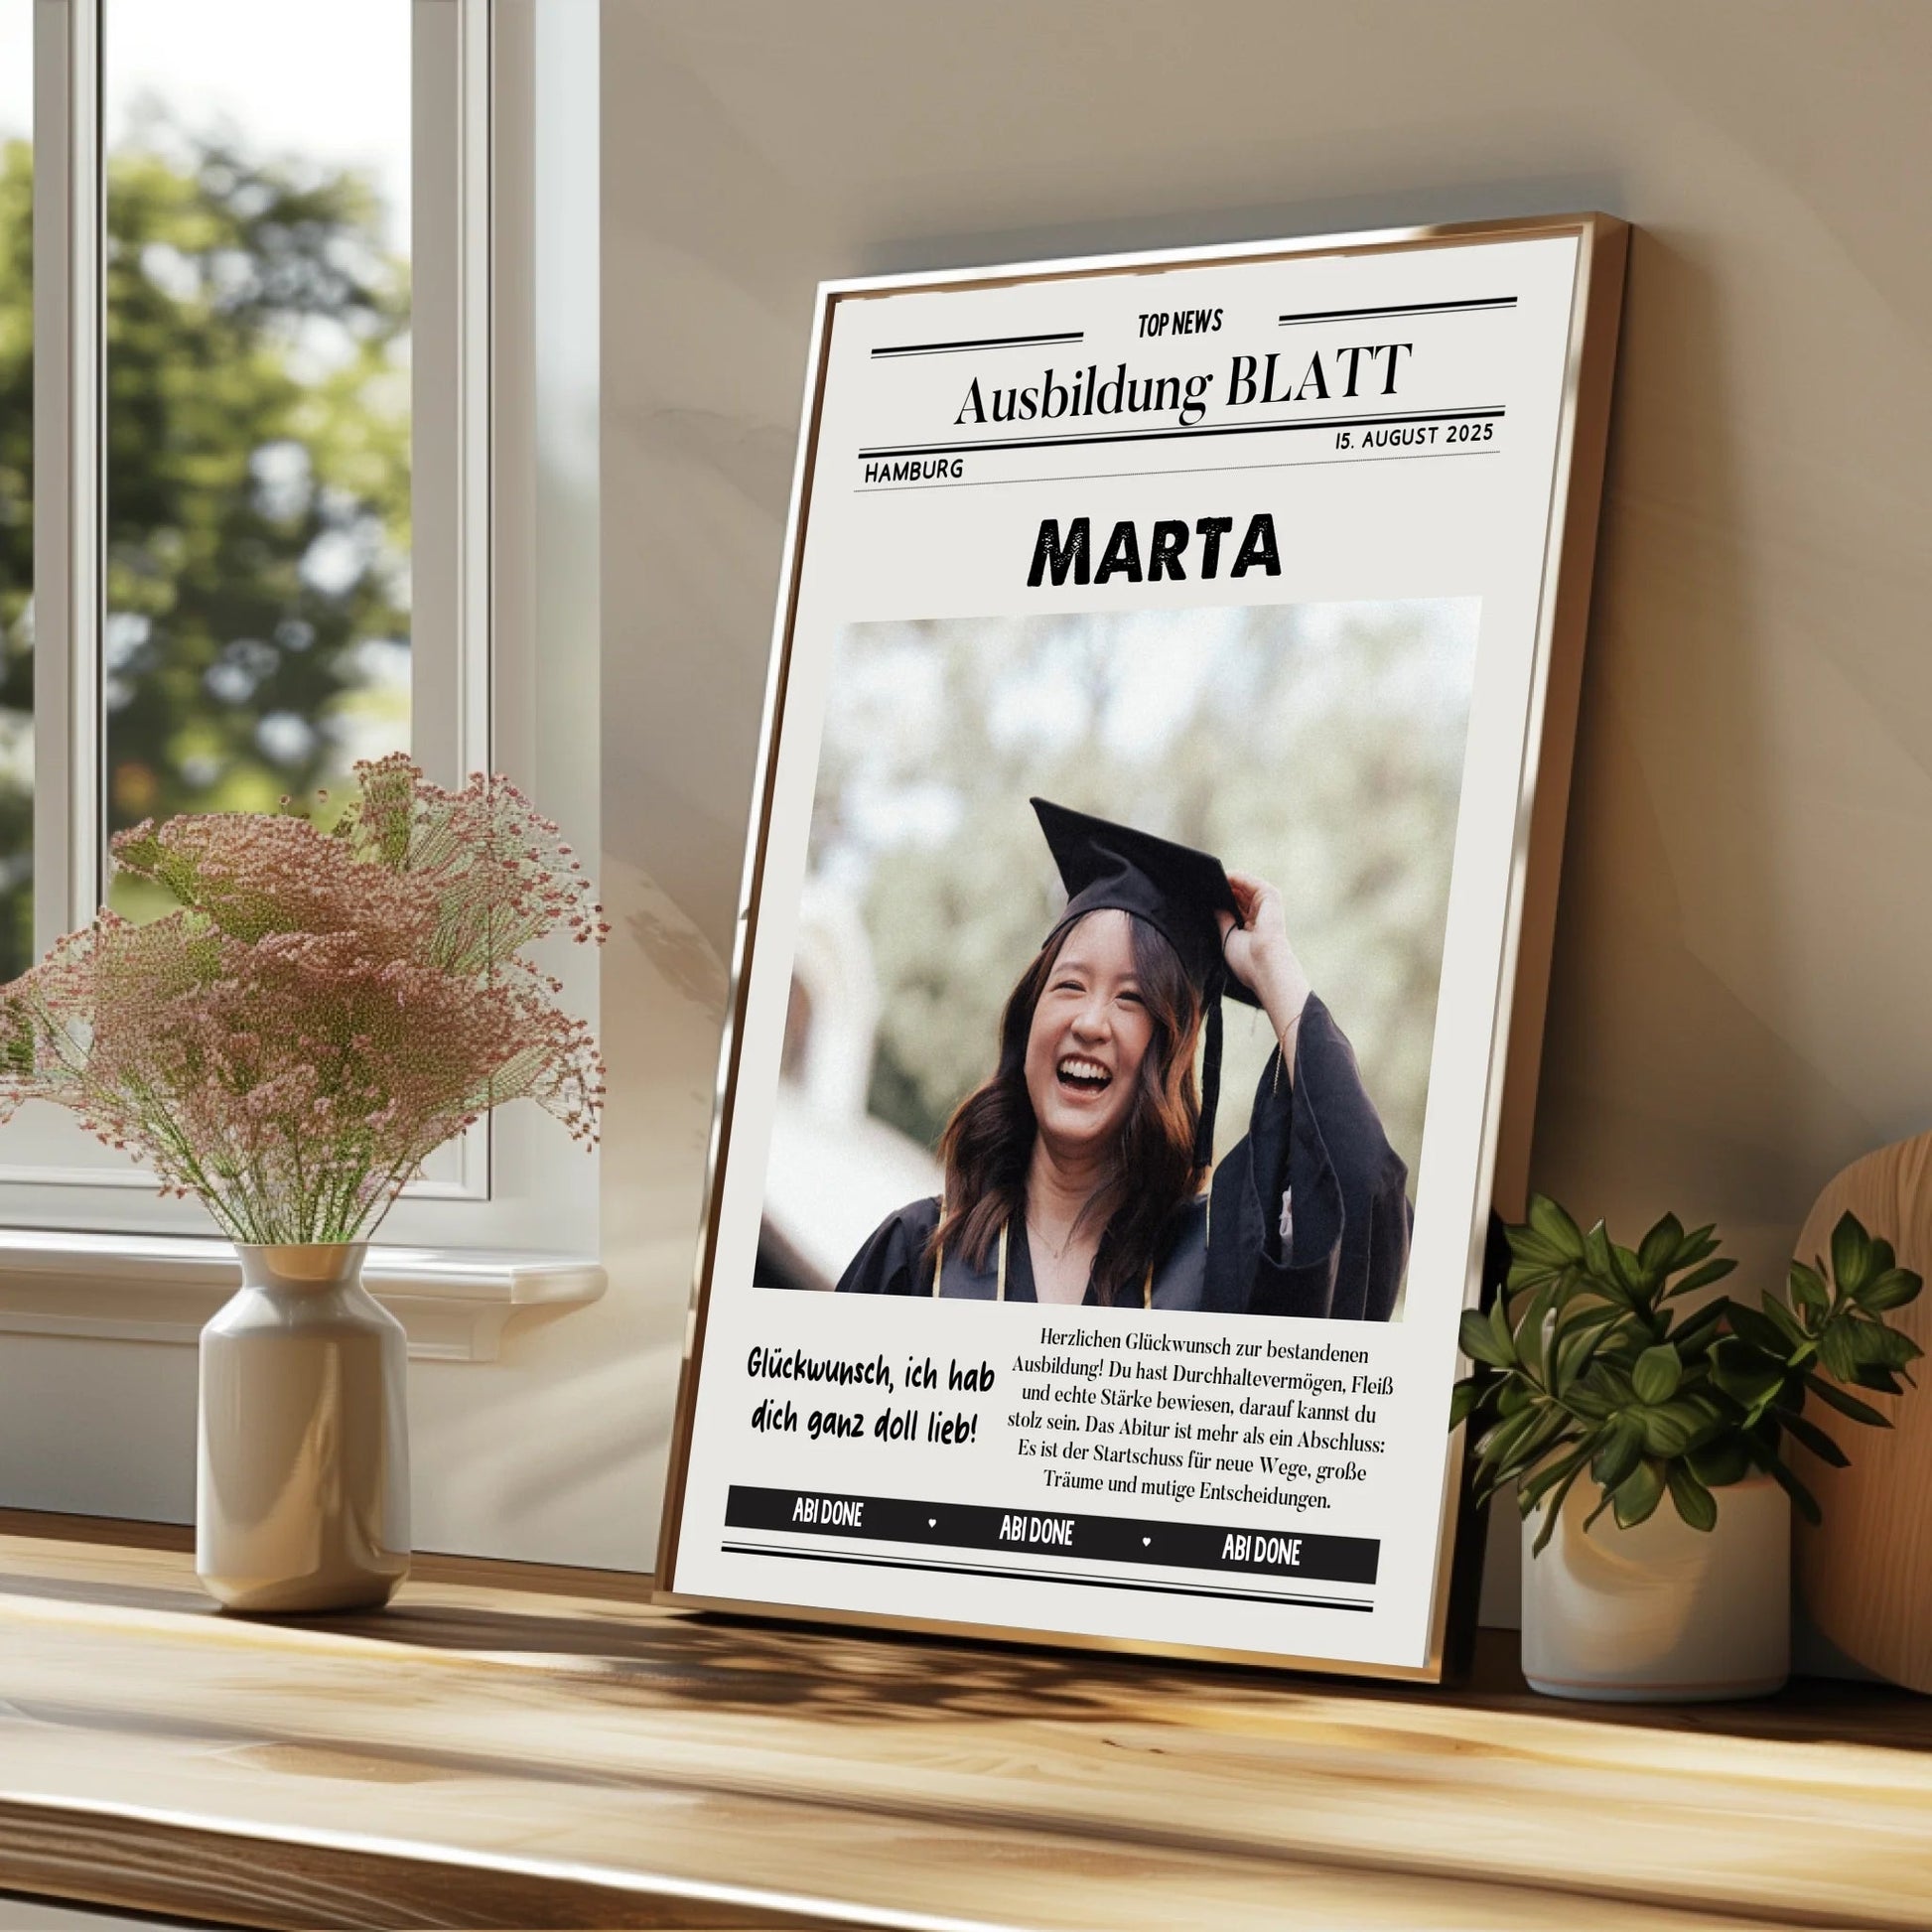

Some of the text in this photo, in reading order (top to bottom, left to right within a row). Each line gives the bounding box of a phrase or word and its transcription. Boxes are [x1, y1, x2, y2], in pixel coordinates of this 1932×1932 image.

[1138, 308, 1224, 339] TOP NEWS
[953, 343, 1414, 427] Ausbildung BLATT
[1335, 422, 1494, 450] 15. AUGUST 2025
[864, 458, 964, 483] HAMBURG
[1026, 512, 1282, 588] MARTA
[1039, 1327, 1369, 1364] Herzlichen Glückwunsch zur bestandenen
[747, 1345, 996, 1395] Glückwunsch, ich hab
[1012, 1355, 1394, 1397] Ausbildung! Du hast Durchhaltevermögen, Fleiß
[751, 1398, 978, 1446] dich ganz doll lieb!
[1022, 1383, 1376, 1424] und echte Stärke bewiesen, darauf kannst du
[1007, 1410, 1385, 1453] stolz sein. Das Abitur ist mehr als ein Abschluss:
[1018, 1438, 1367, 1484] Es ist der Startschuss für neue Wege, große
[1043, 1468, 1331, 1513] Träume und mutige Entscheidungen.
[791, 1496, 865, 1528] ABI DONE
[998, 1514, 1075, 1546] ABI DONE
[1221, 1533, 1303, 1567] ABI DONE
